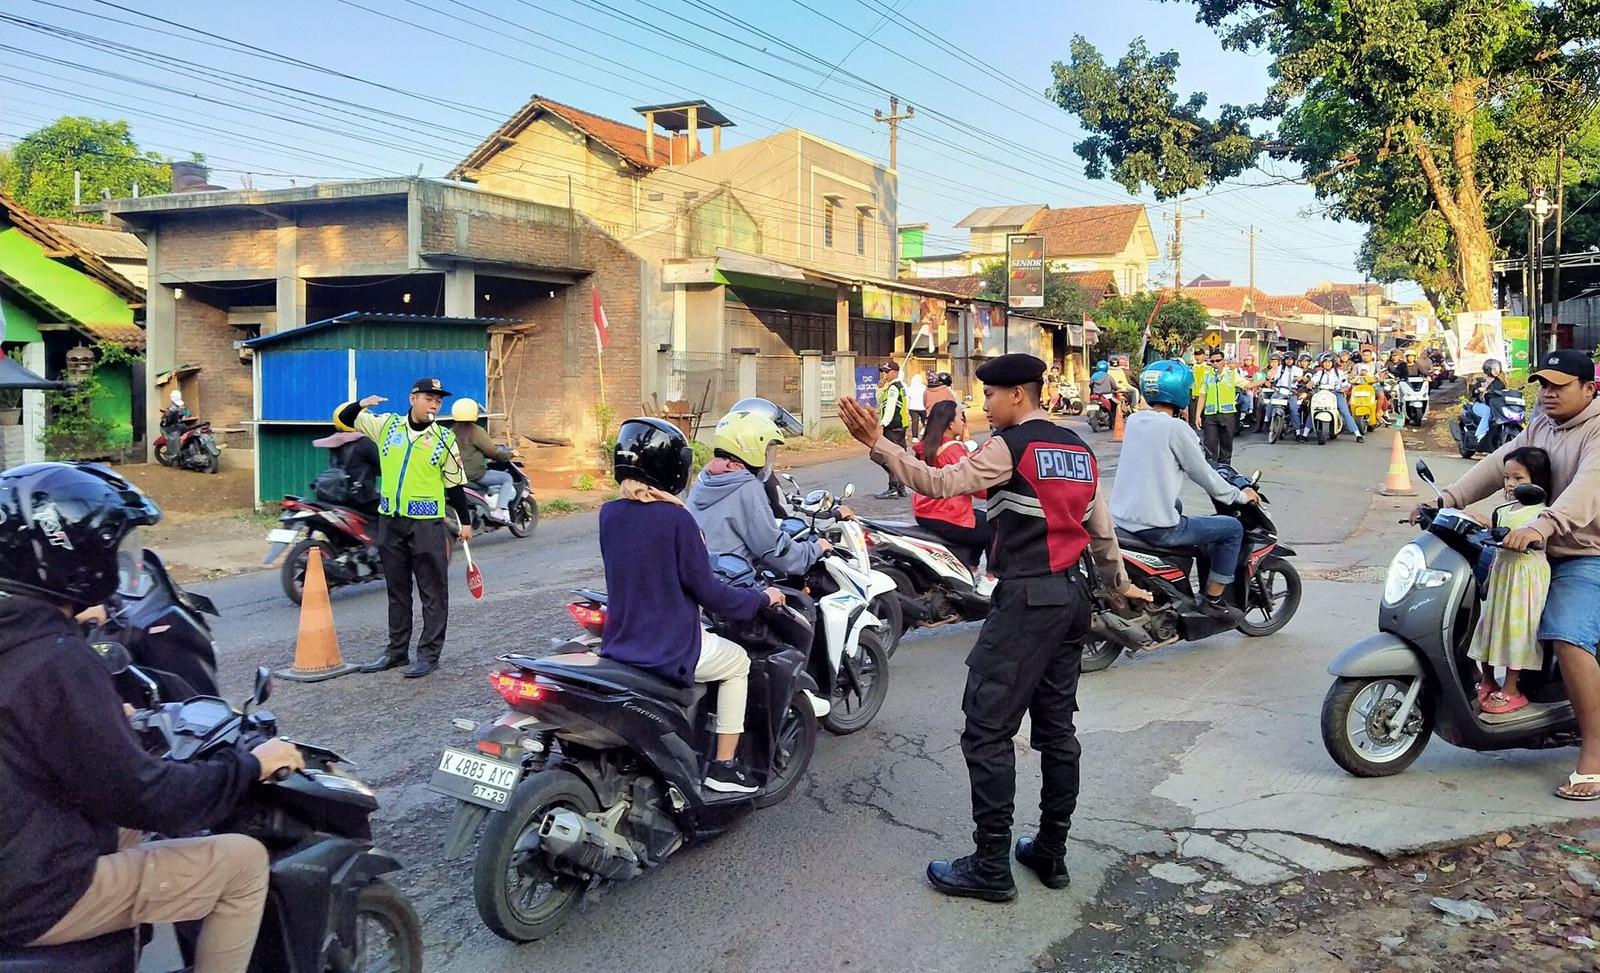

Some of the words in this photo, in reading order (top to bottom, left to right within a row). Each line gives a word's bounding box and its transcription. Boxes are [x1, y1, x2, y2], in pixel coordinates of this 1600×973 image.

[1011, 259, 1042, 267] SENIOR
[1038, 451, 1092, 480] POLISI
[443, 753, 453, 770] K
[456, 758, 487, 779] 4885
[488, 767, 513, 786] AYC
